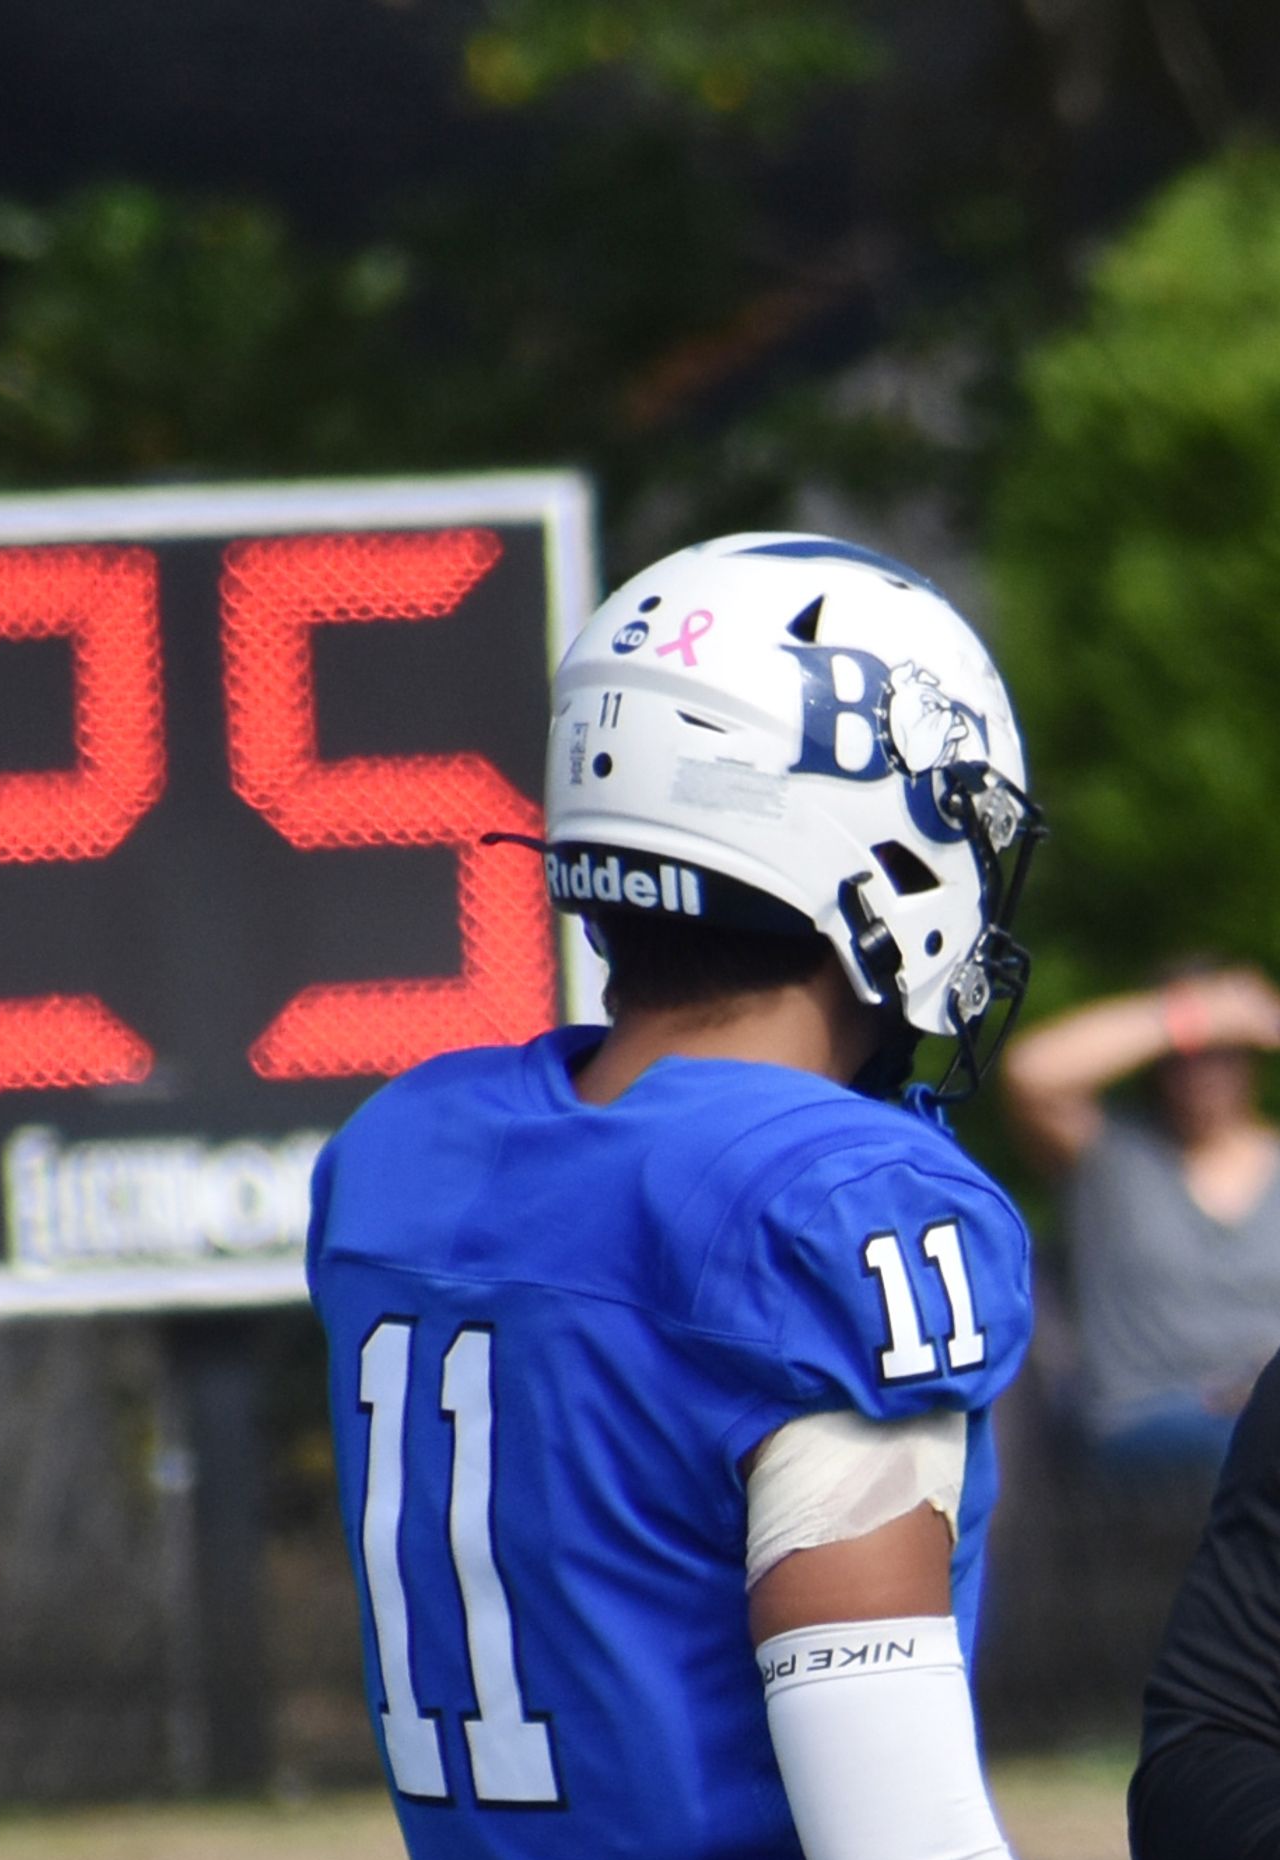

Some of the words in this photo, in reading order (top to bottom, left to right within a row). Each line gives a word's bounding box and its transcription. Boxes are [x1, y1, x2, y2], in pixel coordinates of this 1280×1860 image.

[599, 692, 622, 728] 11
[547, 852, 700, 916] Riddell
[864, 1217, 986, 1386] 11
[359, 1314, 567, 1811] 11
[806, 1638, 915, 1672] NIKE
